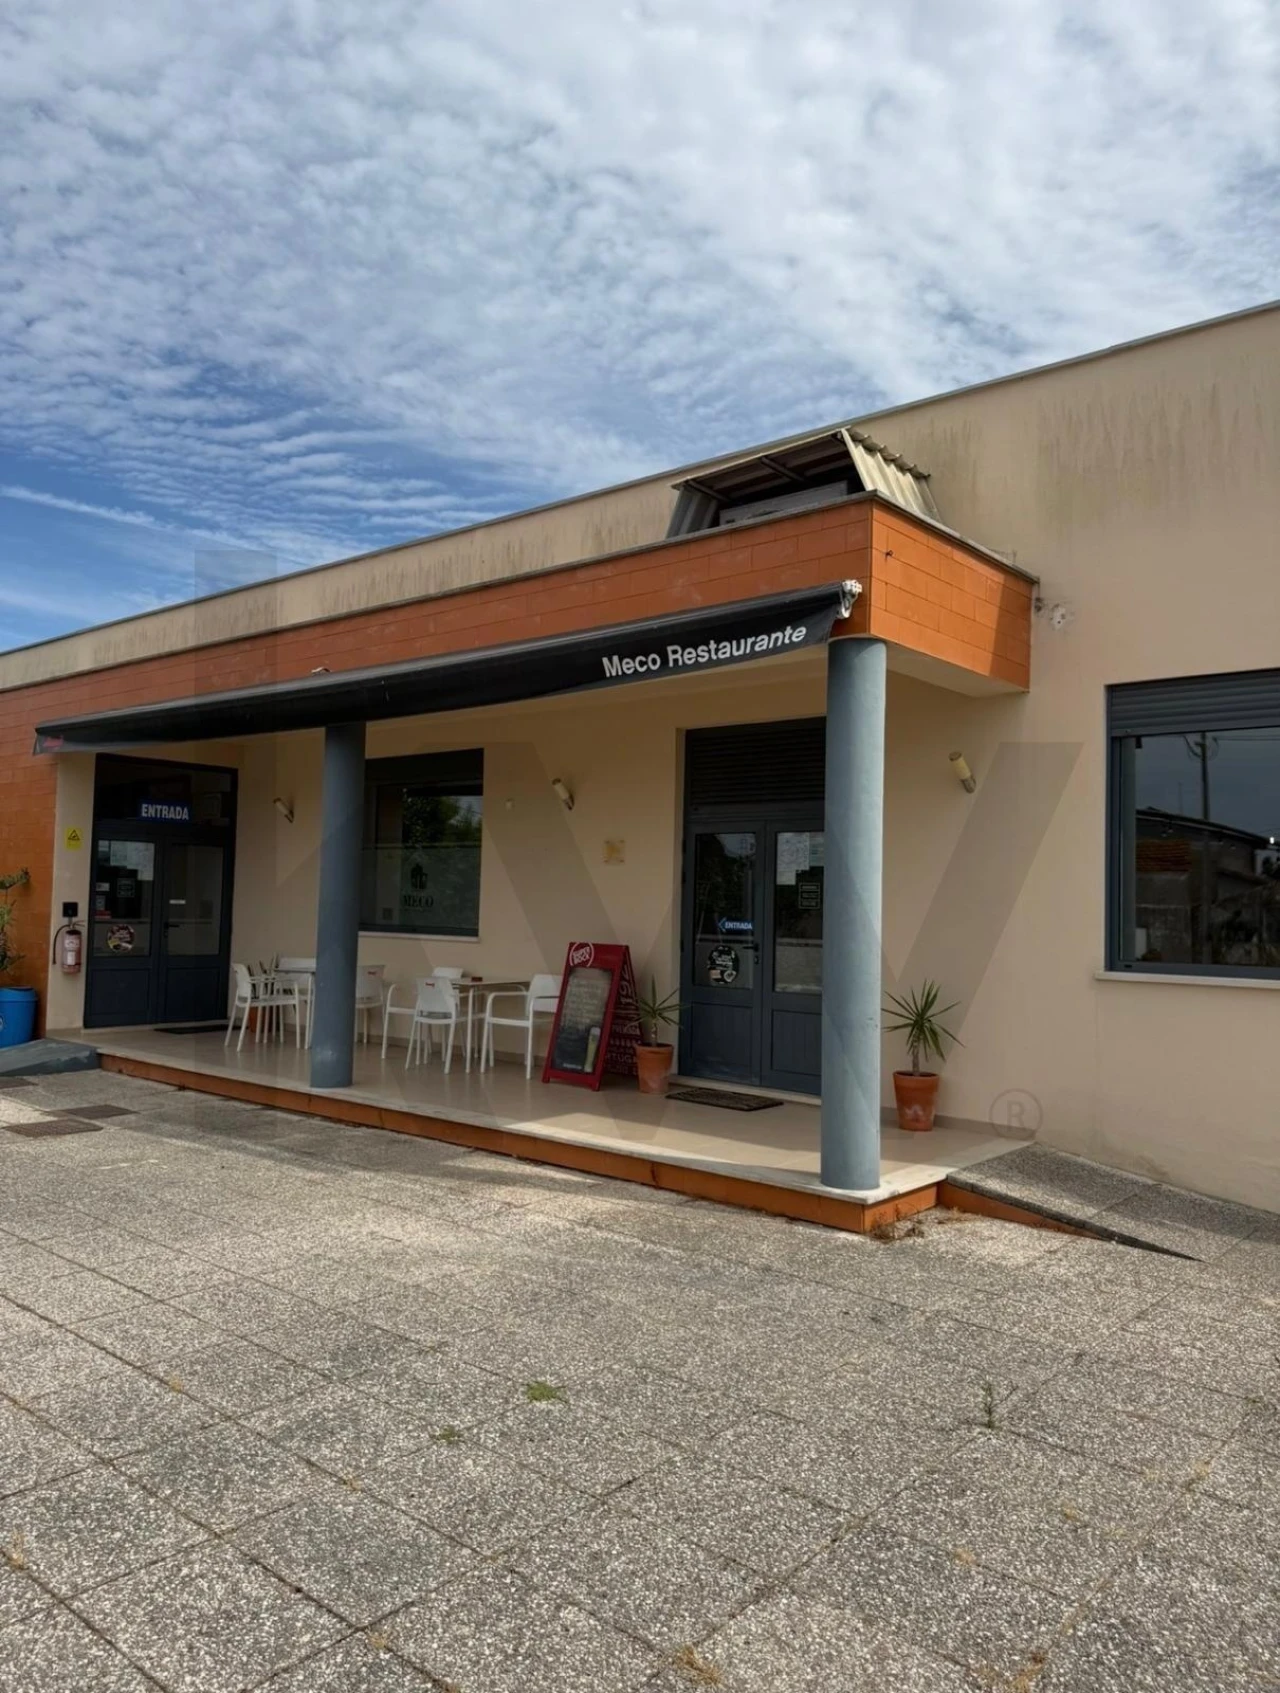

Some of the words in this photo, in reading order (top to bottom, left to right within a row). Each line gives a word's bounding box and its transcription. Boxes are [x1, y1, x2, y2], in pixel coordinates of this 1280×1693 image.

[602, 654, 661, 678] Meco
[667, 625, 807, 668] Restaurante
[141, 803, 190, 820] ENTRADA
[725, 920, 753, 930] ENTRADA
